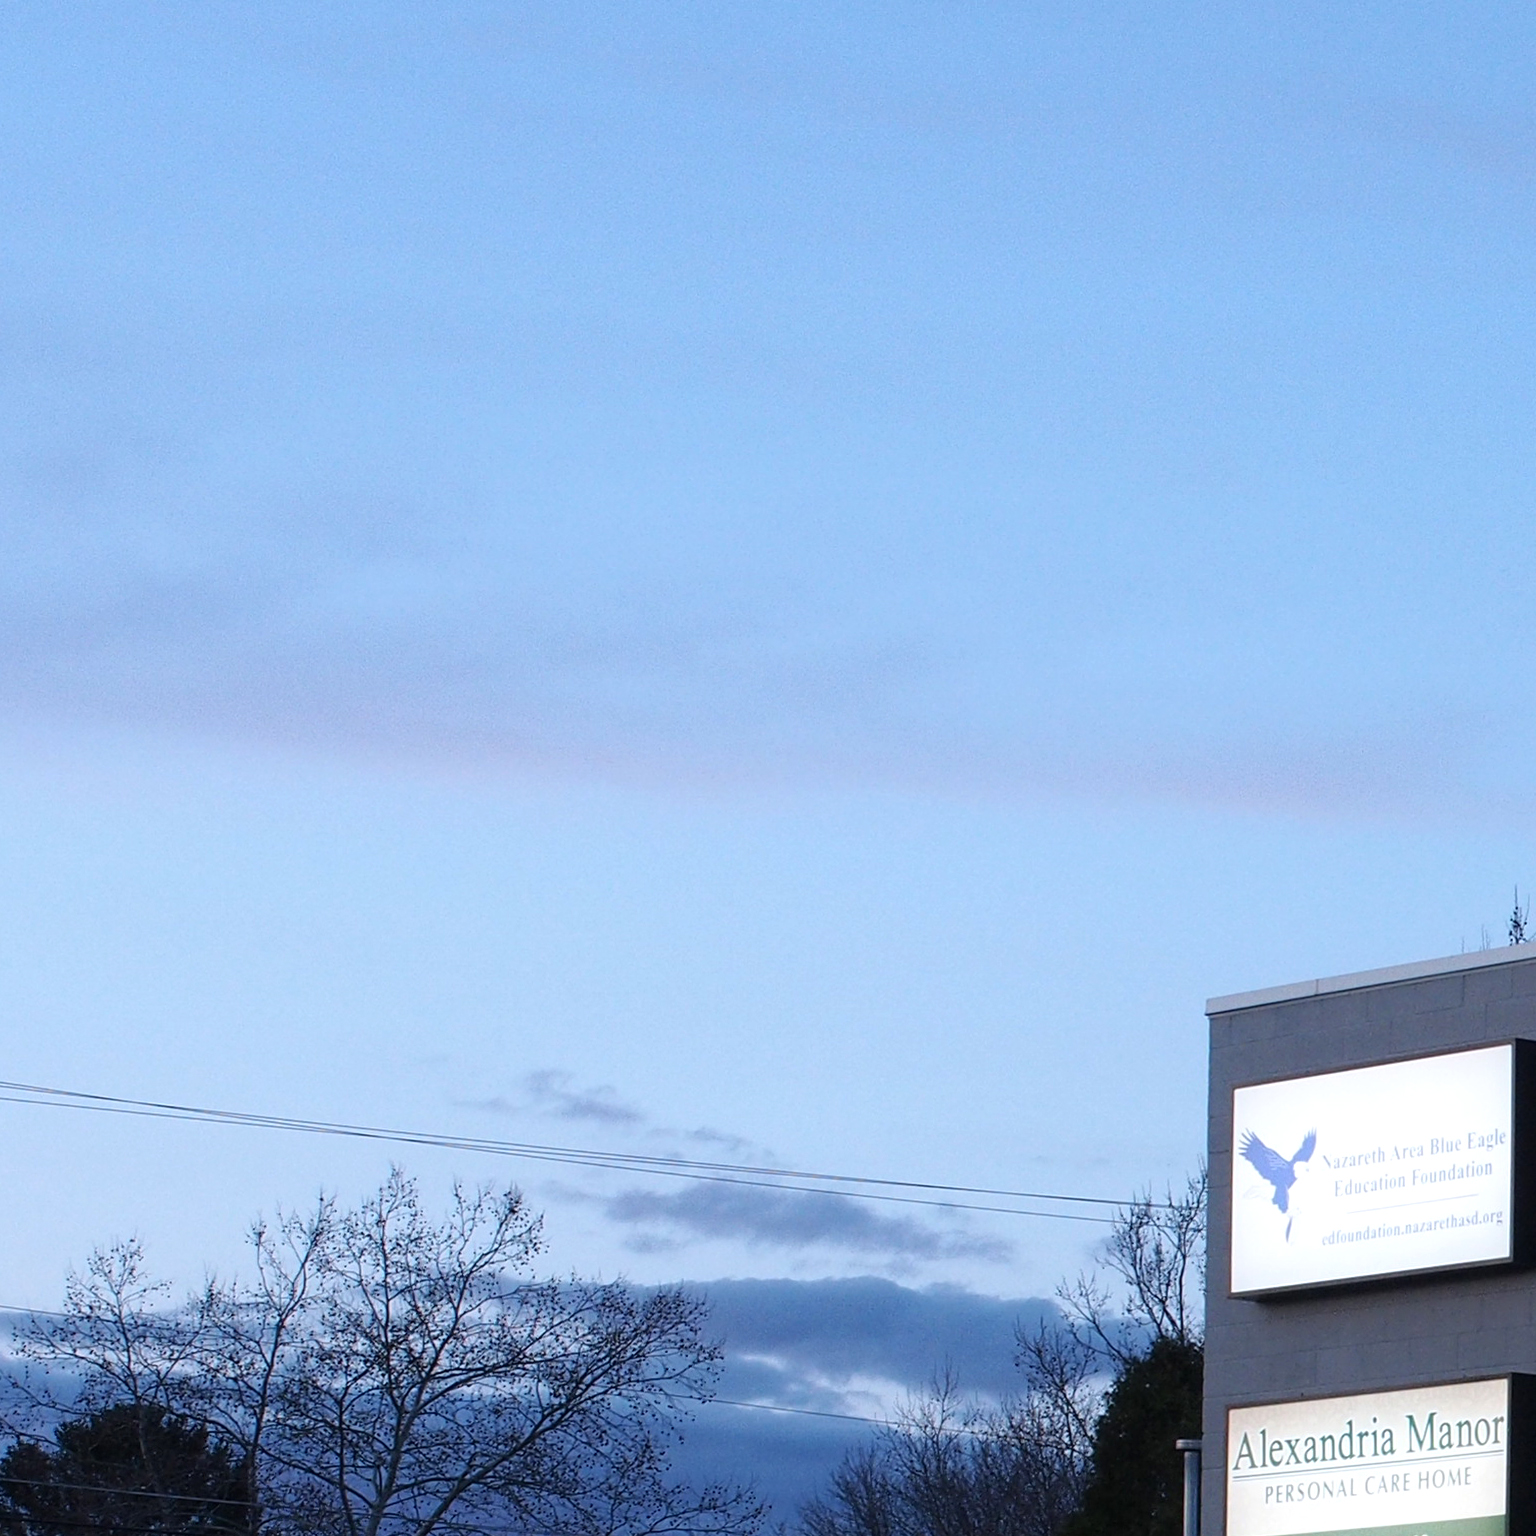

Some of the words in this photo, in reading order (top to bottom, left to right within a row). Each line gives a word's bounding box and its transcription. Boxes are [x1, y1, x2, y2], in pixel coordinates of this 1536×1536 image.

[1322, 1146, 1386, 1171] Nazareth
[1390, 1144, 1425, 1162] Area
[1429, 1136, 1462, 1156] Blue
[1467, 1127, 1507, 1152] Eagle
[1334, 1173, 1406, 1198] Education
[1412, 1161, 1494, 1187] Foundation
[1231, 1417, 1397, 1471] Alexandria
[1405, 1411, 1505, 1454] Manor
[1264, 1479, 1358, 1504] PERSONAL
[1364, 1473, 1411, 1495] CARE
[1417, 1466, 1473, 1490] HOME
